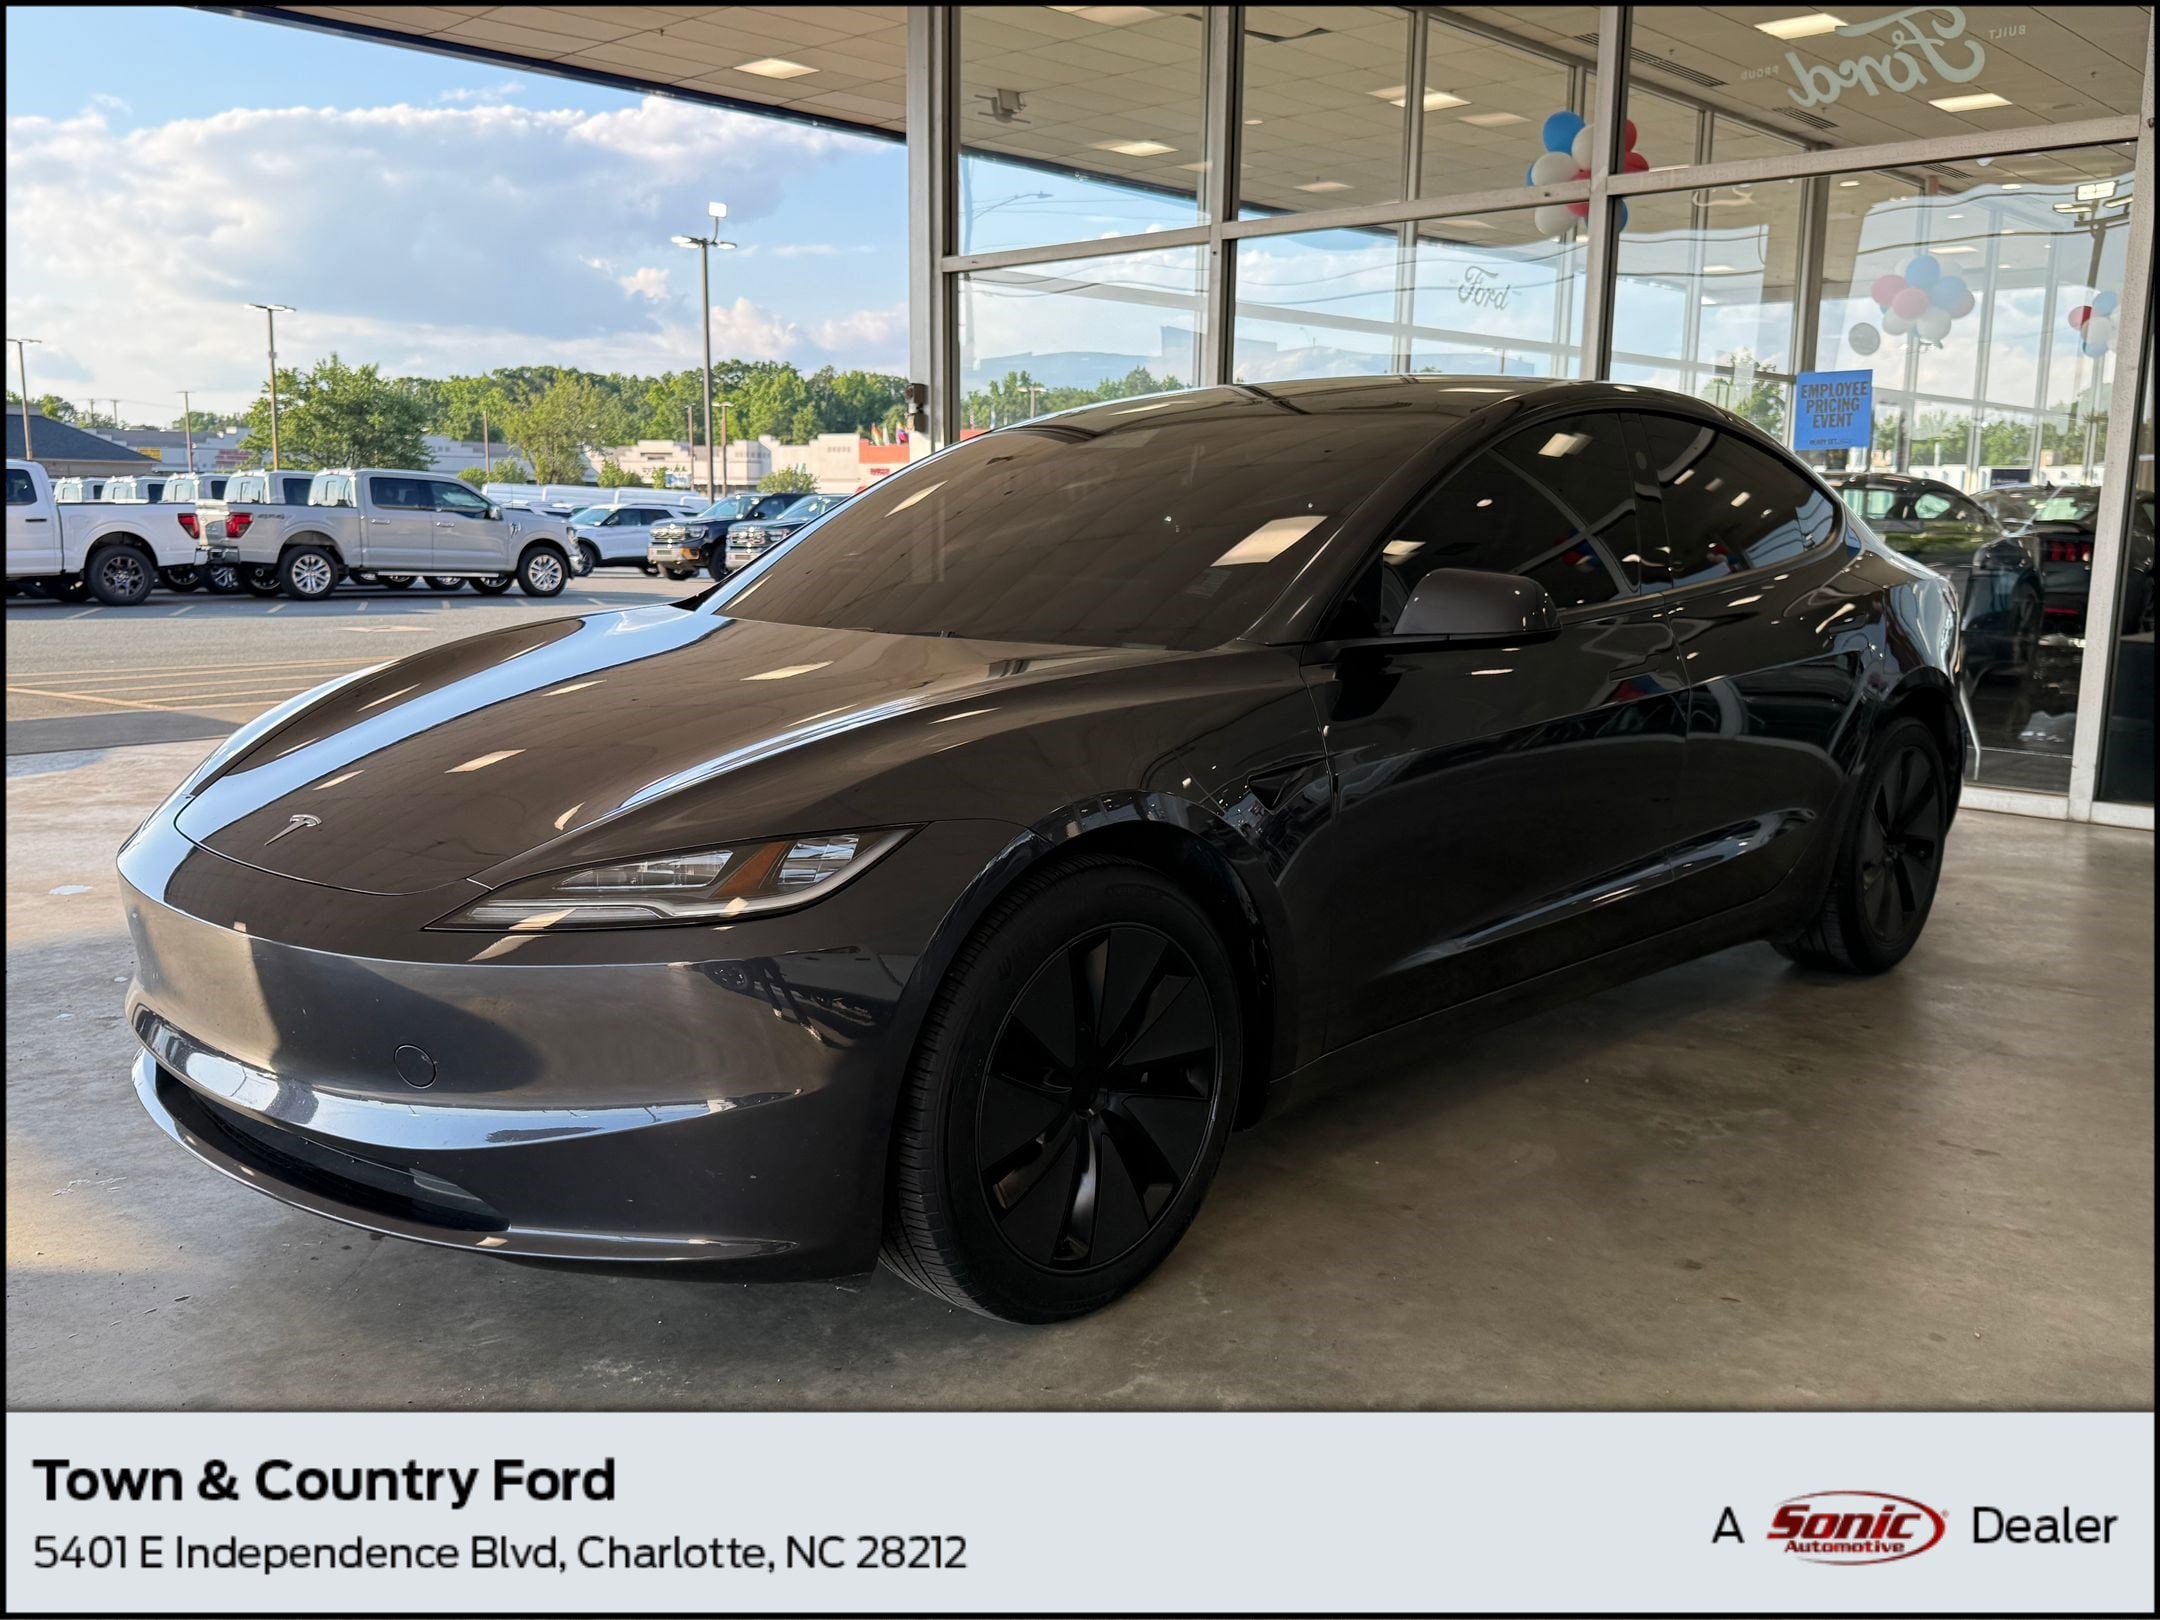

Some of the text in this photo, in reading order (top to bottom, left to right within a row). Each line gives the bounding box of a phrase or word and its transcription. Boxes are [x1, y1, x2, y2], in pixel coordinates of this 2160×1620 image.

[1457, 265, 1511, 311] Ford
[1801, 381, 1869, 399] EMPLOYEE
[1806, 397, 1860, 413] PRICING
[1812, 413, 1853, 428] EVENT
